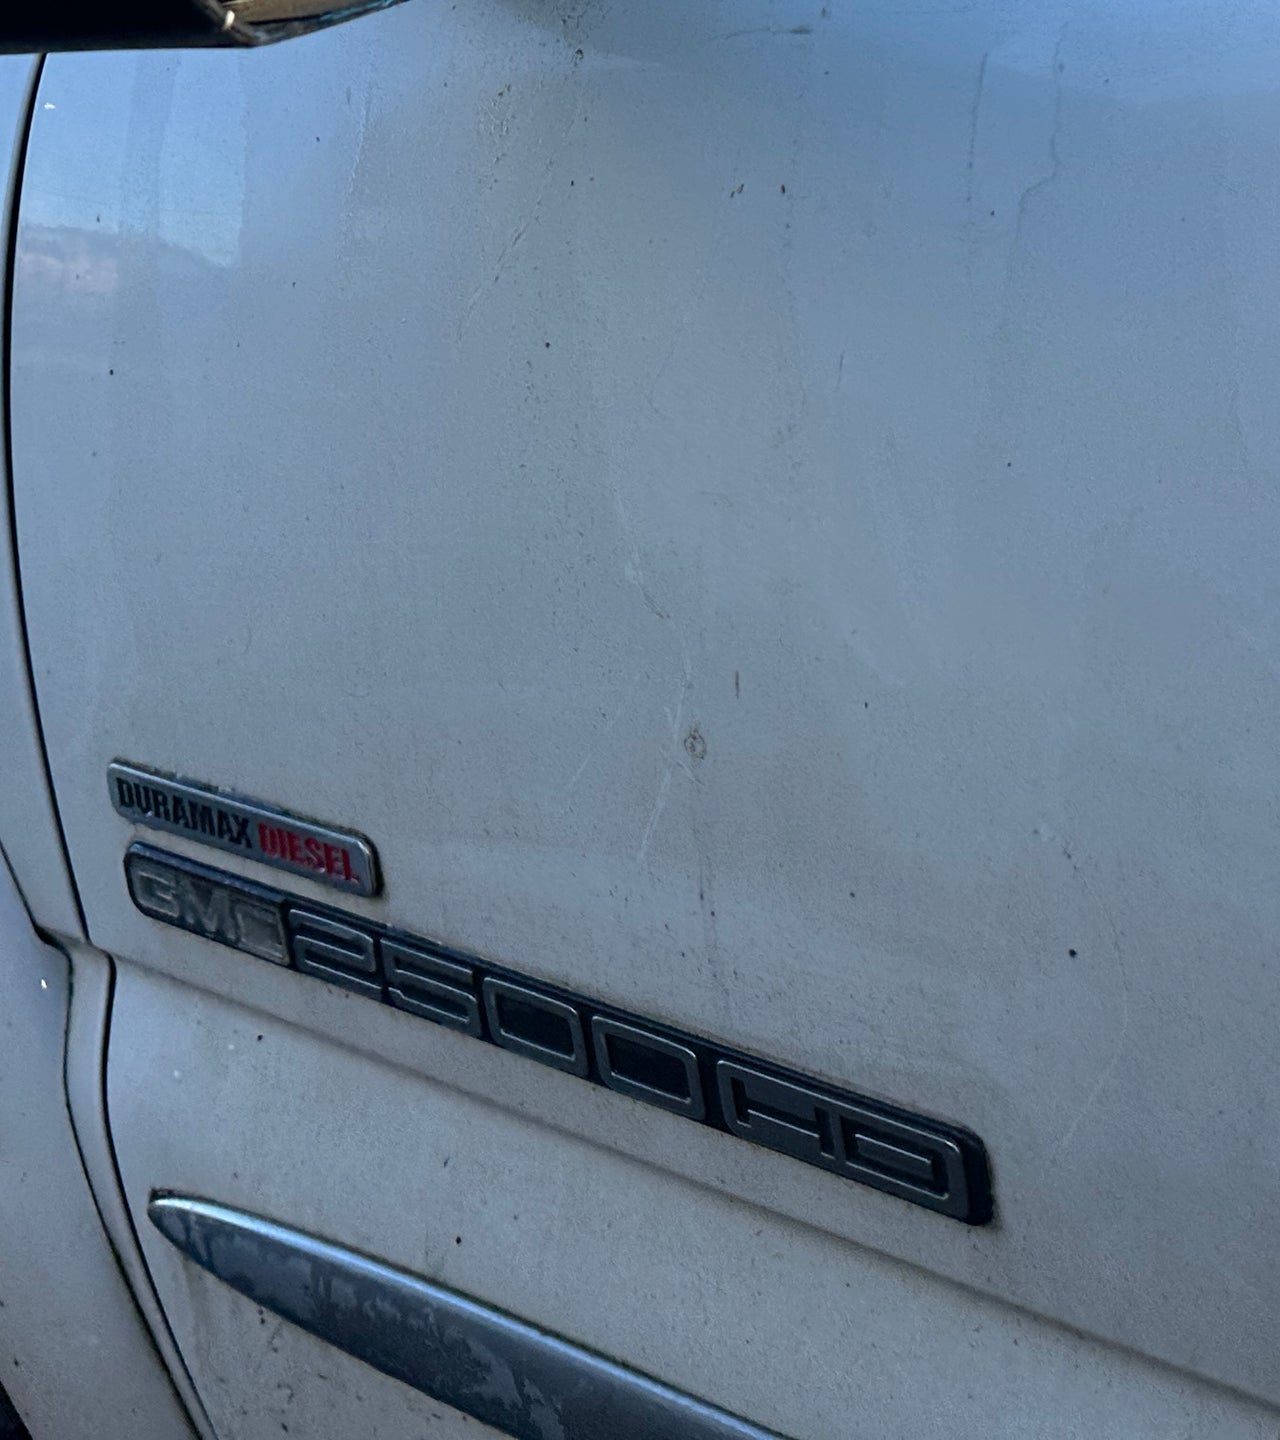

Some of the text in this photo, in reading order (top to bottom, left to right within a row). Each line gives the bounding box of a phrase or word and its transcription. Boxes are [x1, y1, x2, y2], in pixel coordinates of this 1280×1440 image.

[116, 776, 361, 885] DURAMAX DIESEL
[134, 866, 291, 966] GMC
